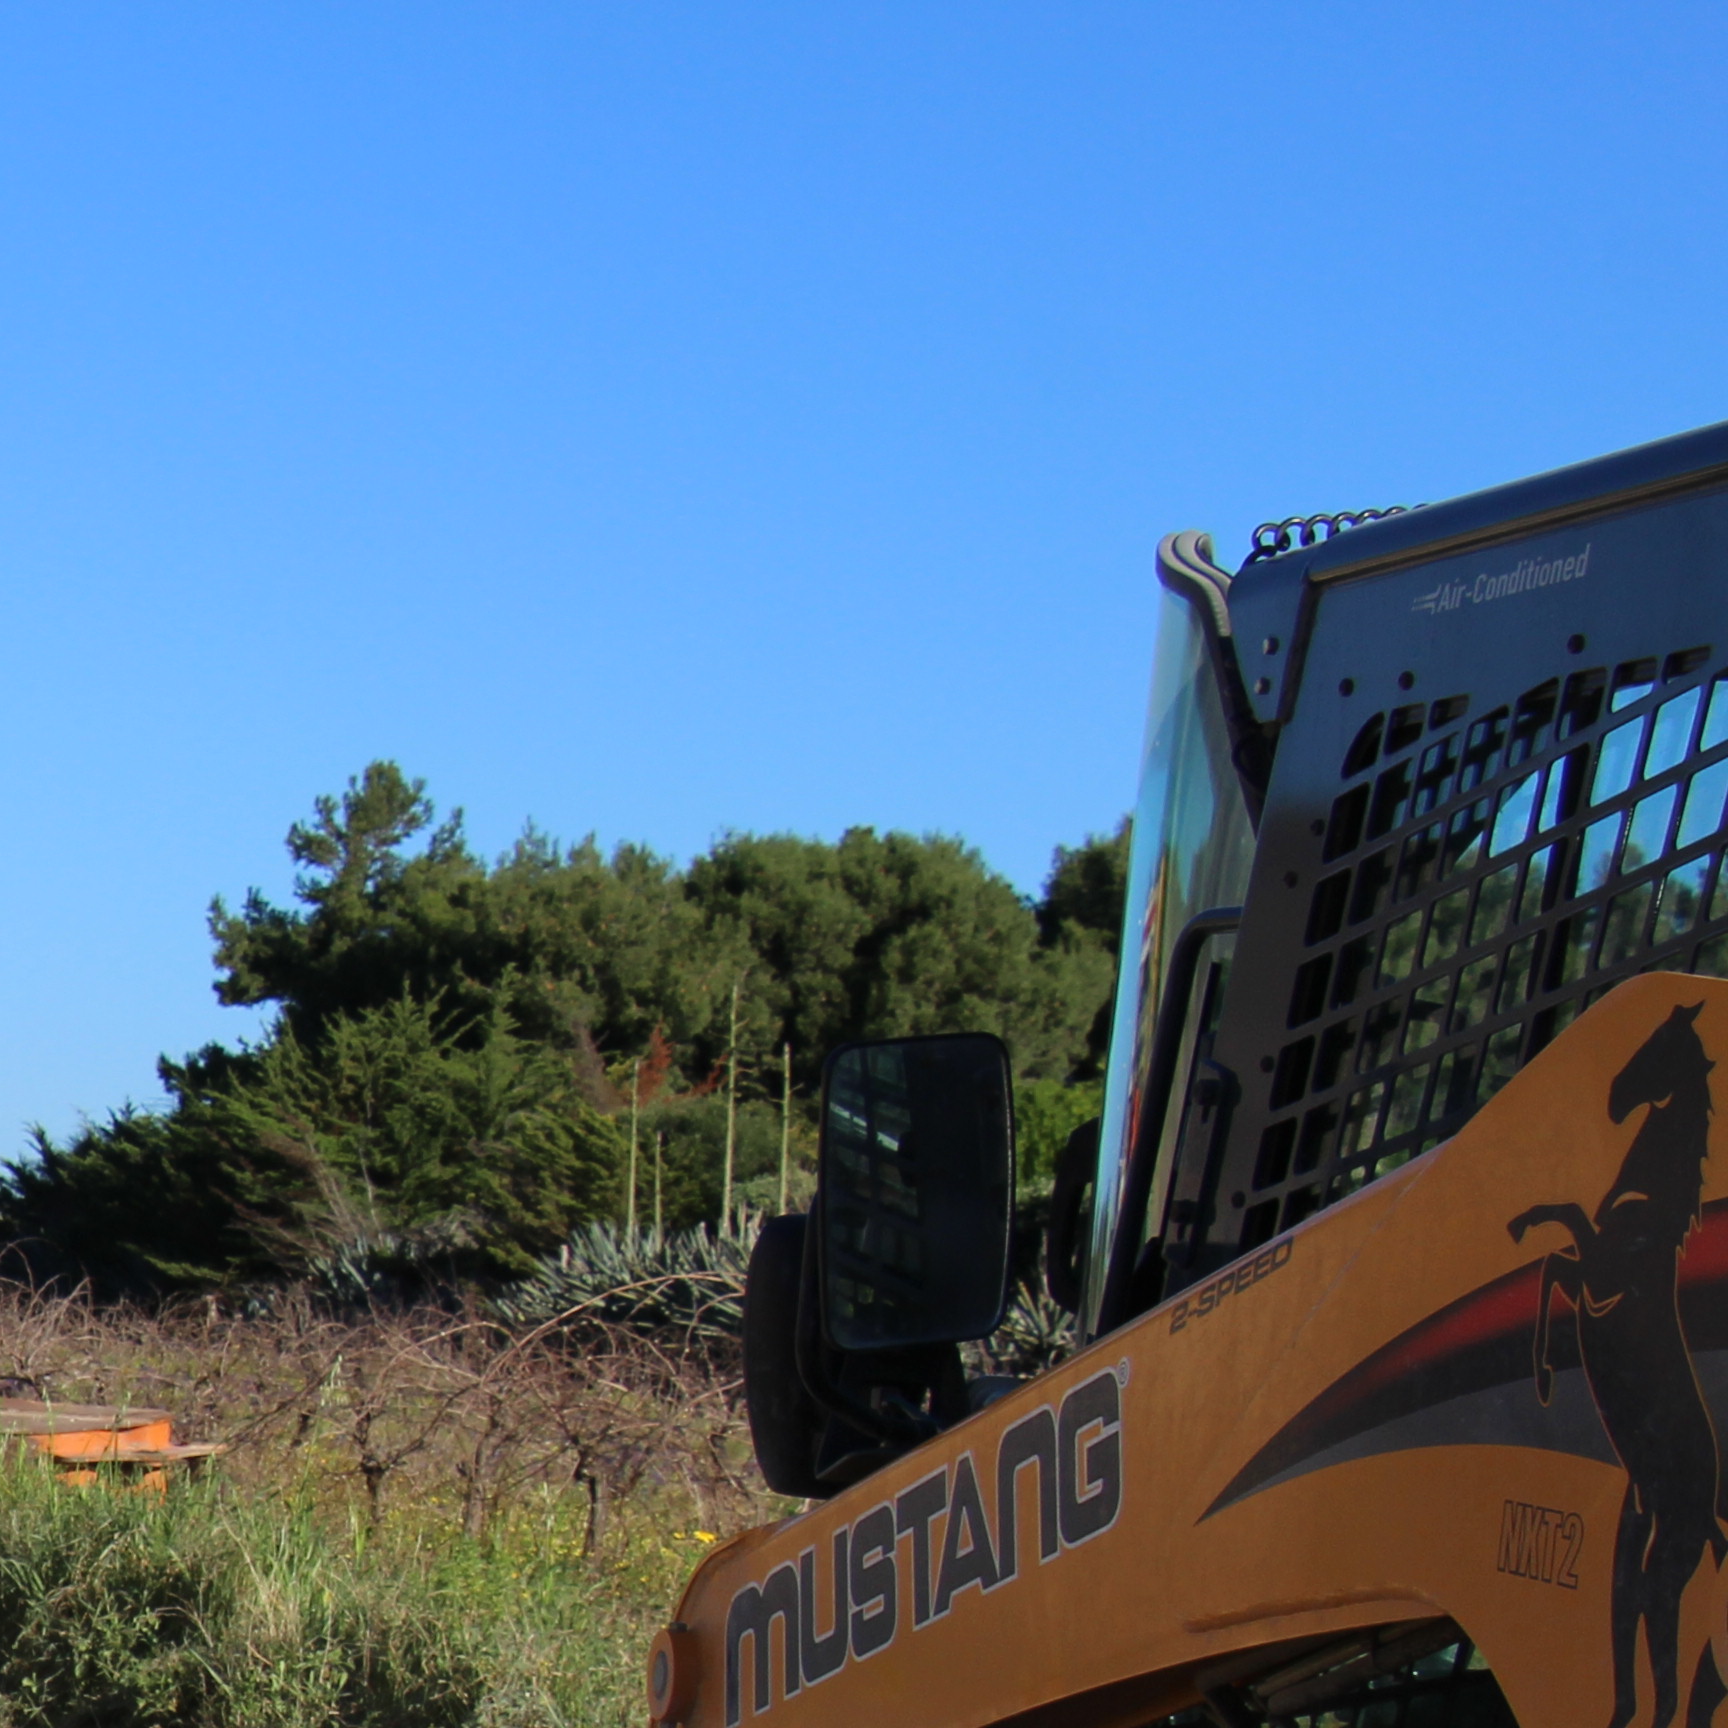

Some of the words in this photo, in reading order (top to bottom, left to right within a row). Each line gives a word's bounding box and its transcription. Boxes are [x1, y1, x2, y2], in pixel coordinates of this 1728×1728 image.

[1437, 542, 1591, 613] Air-Conditioned
[1169, 1236, 1294, 1336] 2-SPEED
[1497, 1499, 1585, 1590] NXT2
